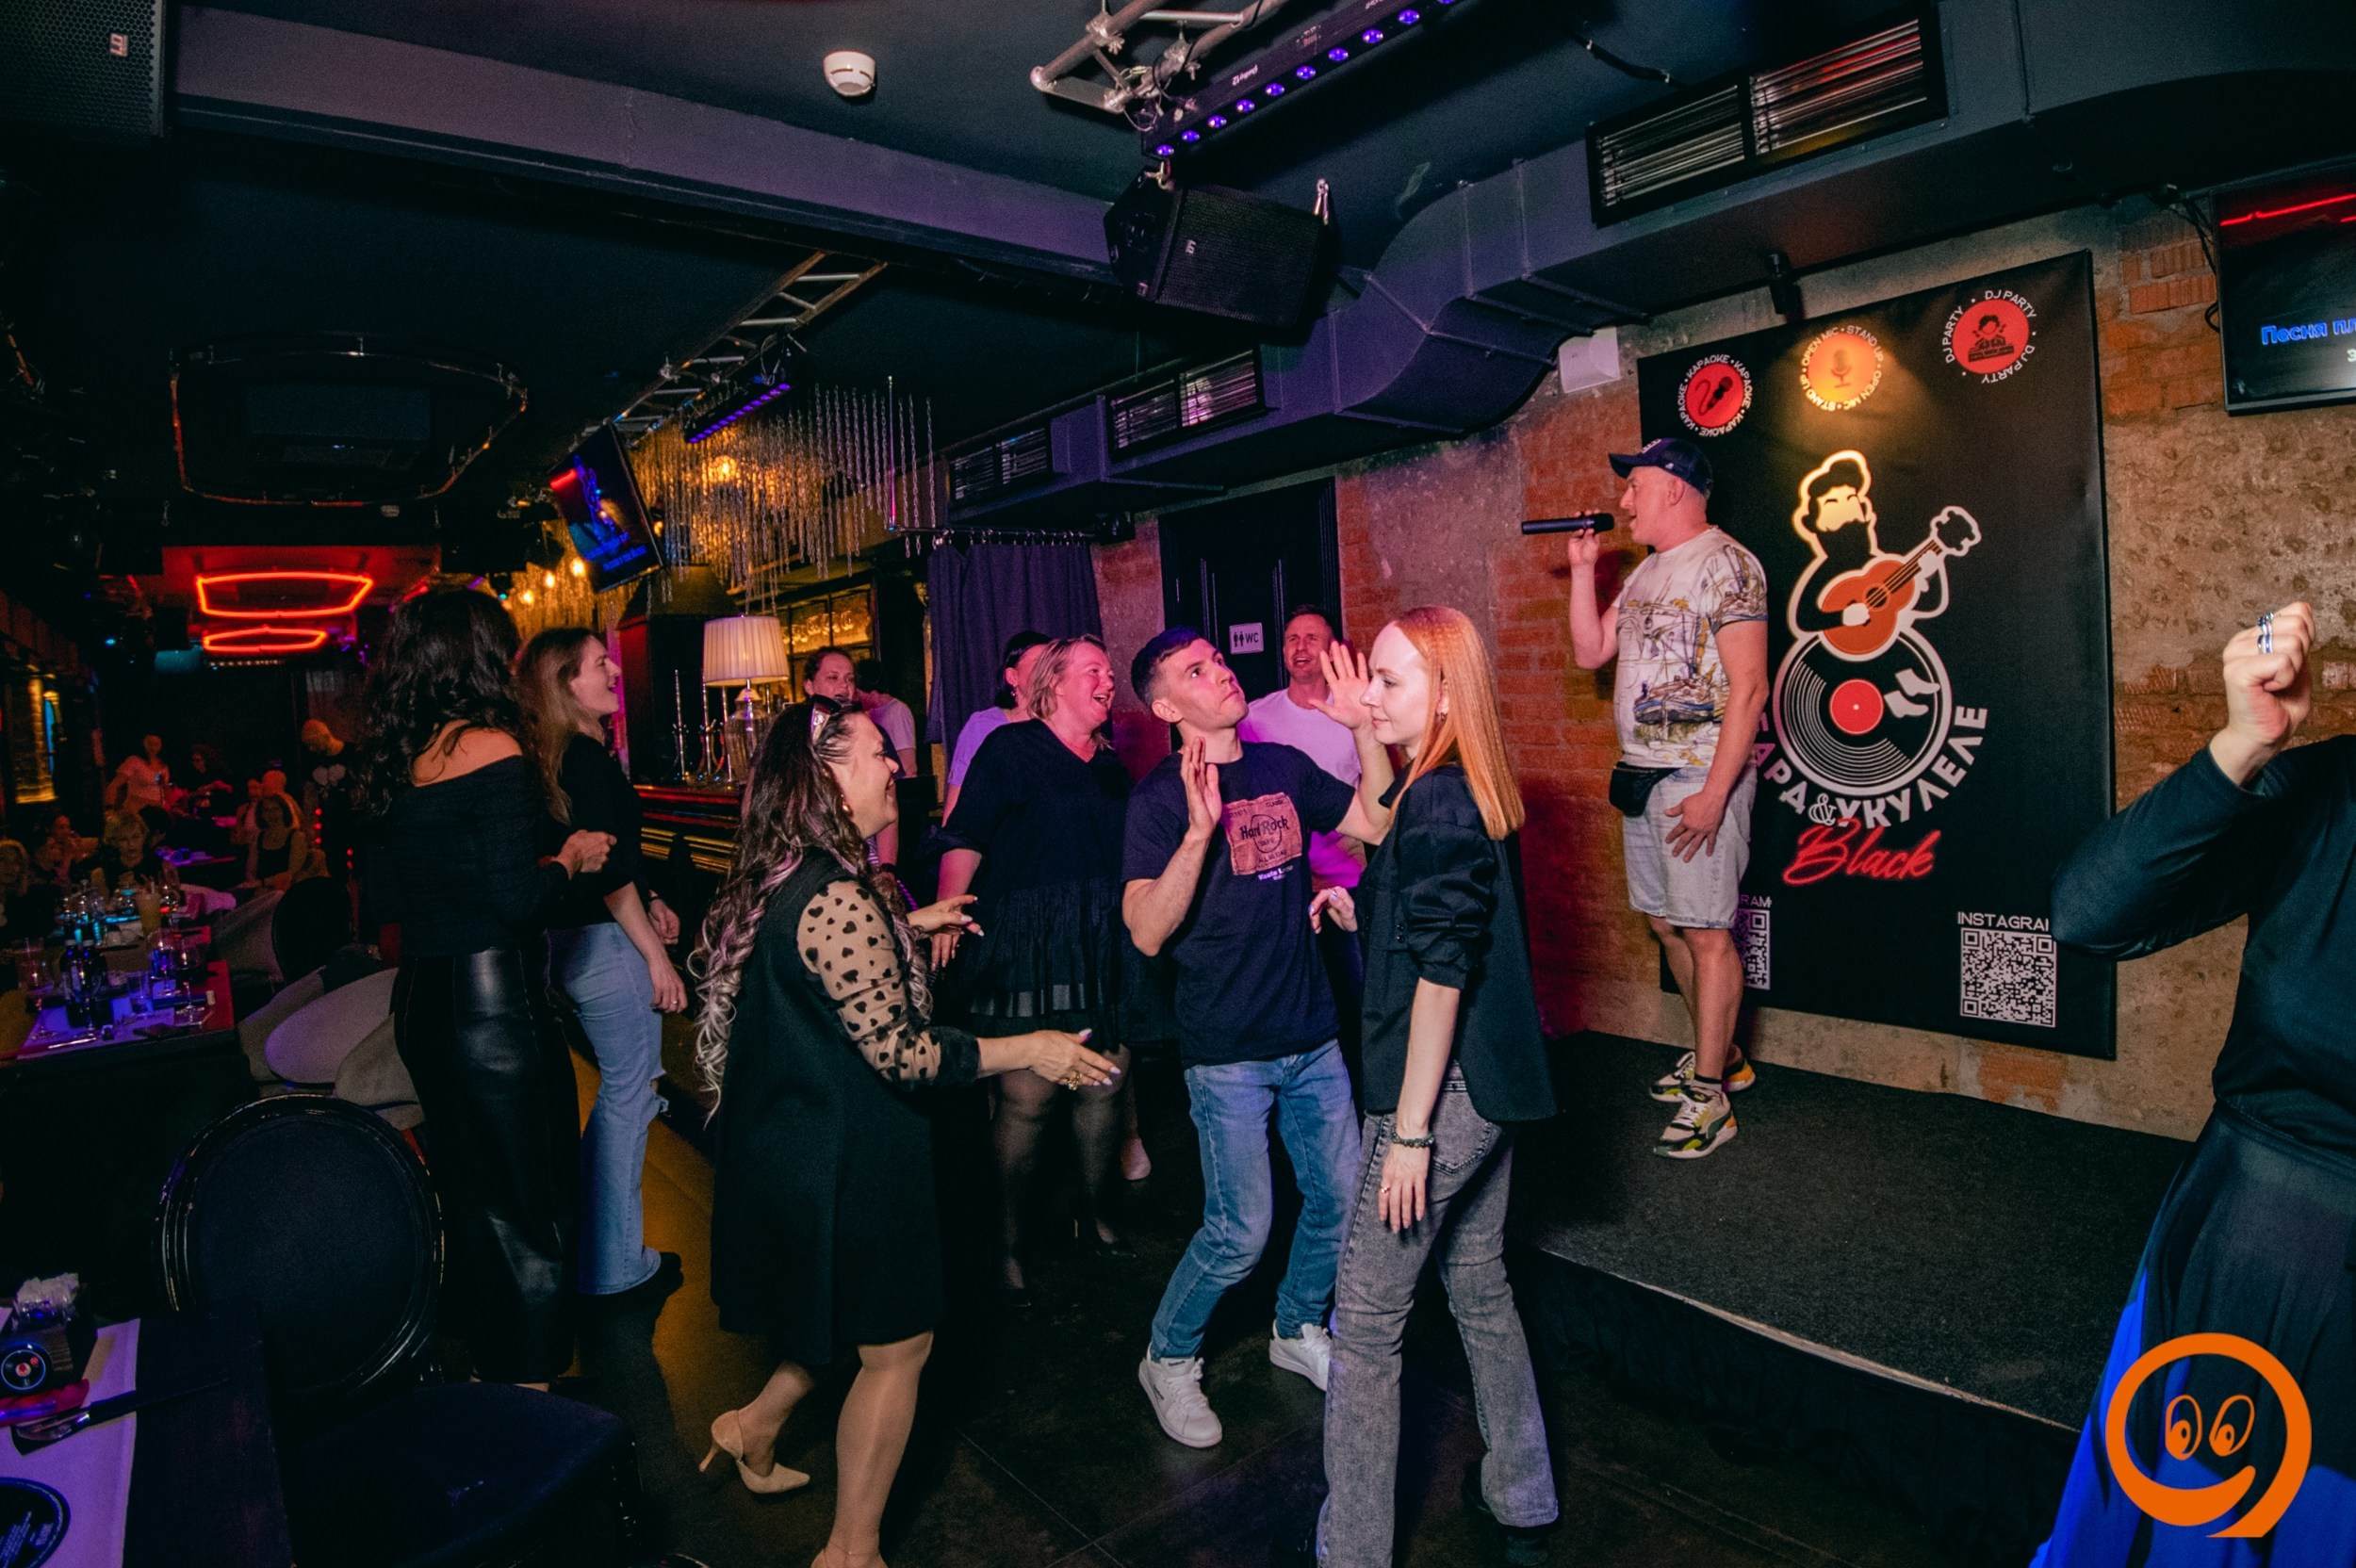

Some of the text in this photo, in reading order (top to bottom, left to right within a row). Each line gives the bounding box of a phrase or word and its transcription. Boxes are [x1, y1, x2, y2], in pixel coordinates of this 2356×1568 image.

[1985, 290, 2037, 318] DJ PARTY
[1801, 325, 1884, 367] OPEN MIC STAND UP
[1942, 306, 1963, 364] DJ PARTY
[2261, 321, 2328, 346] Песня
[1981, 345, 2036, 384] DJ PARTY
[1800, 370, 1882, 412] OPEN MIC STAND UP
[1245, 632, 1259, 644] WC
[1239, 815, 1289, 840] Hard Rock
[1782, 817, 1941, 886] Black
[1957, 911, 2050, 932] INSTAGRA
